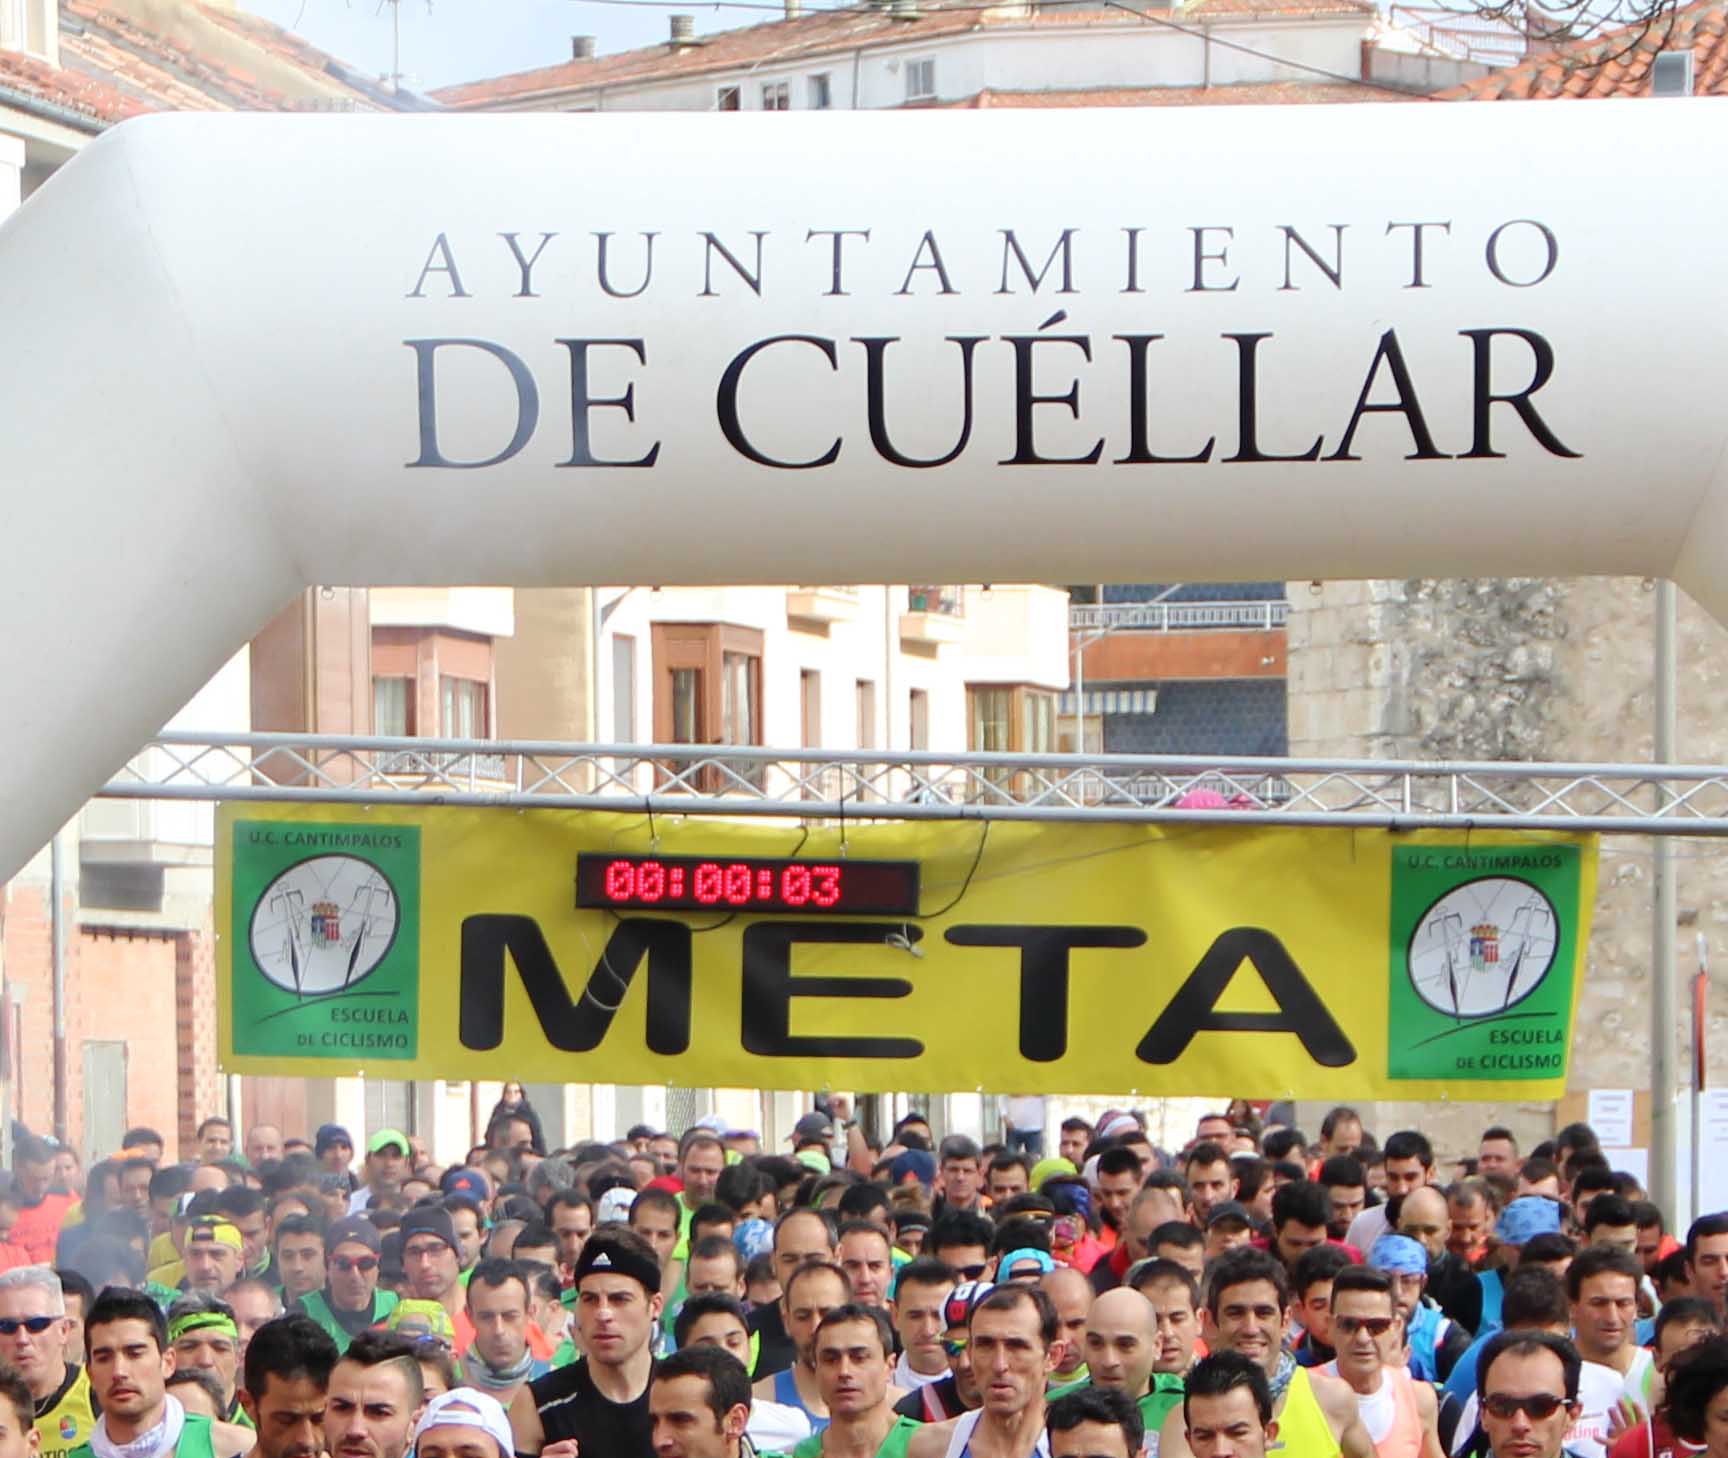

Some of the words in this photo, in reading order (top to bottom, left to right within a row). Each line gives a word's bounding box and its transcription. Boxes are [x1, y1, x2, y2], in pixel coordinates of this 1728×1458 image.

[404, 220, 1562, 299] AYUNTAMIENTO
[403, 337, 660, 470] DE
[715, 310, 1584, 467] CUÉLLAR
[249, 831, 278, 847] U.C.
[283, 831, 403, 849] CANTIMPALOS
[1443, 855, 1562, 870] CANTIMPALOS
[606, 861, 840, 905] 00:00:03
[459, 912, 1359, 1066] META
[331, 1008, 409, 1025] ESCUELA
[321, 1032, 409, 1050] CICLISMO
[1489, 1029, 1564, 1045] ESCUELA
[1479, 1054, 1562, 1070] CICLISMO
